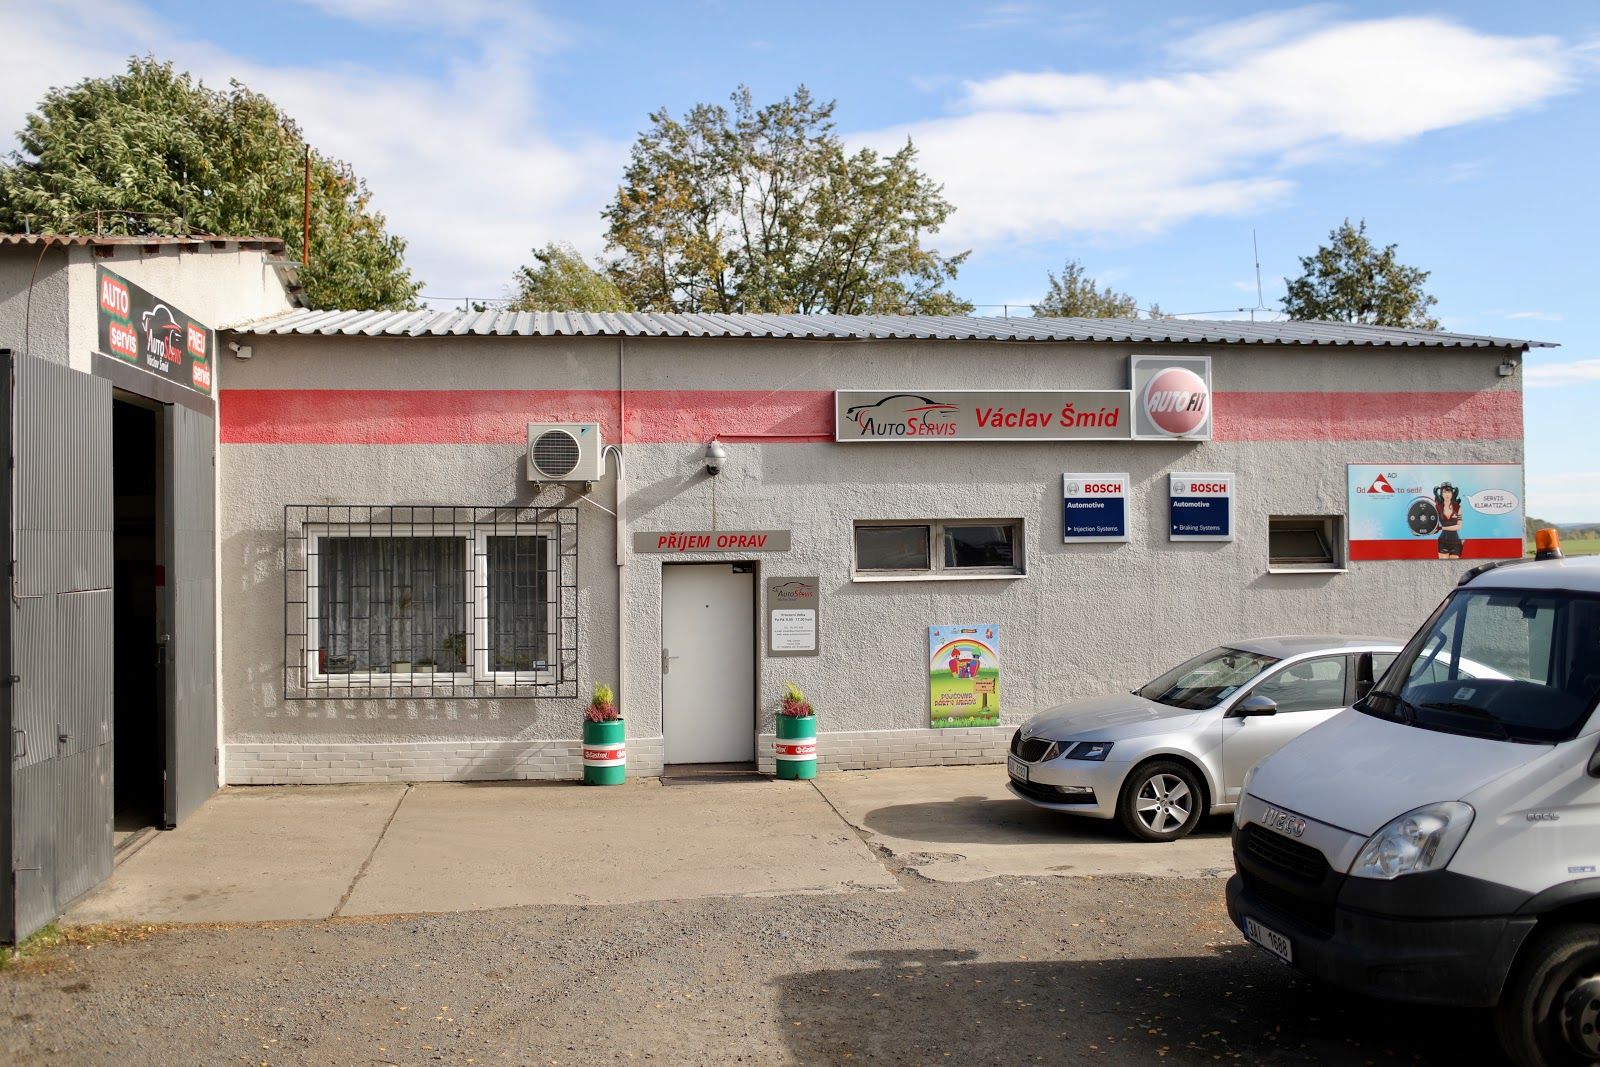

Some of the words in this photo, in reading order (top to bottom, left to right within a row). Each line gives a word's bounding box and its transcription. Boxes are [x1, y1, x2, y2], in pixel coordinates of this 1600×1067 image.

[102, 281, 129, 314] AUTO
[111, 327, 137, 355] servis
[188, 328, 206, 354] PNEU
[193, 365, 210, 386] servis
[975, 406, 1053, 428] Václav
[1060, 402, 1120, 428] Šmíd
[1084, 484, 1121, 493] BOSCH
[1190, 483, 1227, 493] BOSCH
[1179, 524, 1199, 532] Braking
[1199, 524, 1221, 532] Systems
[657, 532, 711, 552] PŘÍJEM
[717, 534, 768, 548] OPRAV
[589, 751, 608, 759] Castrol
[1262, 806, 1306, 838] IVECO
